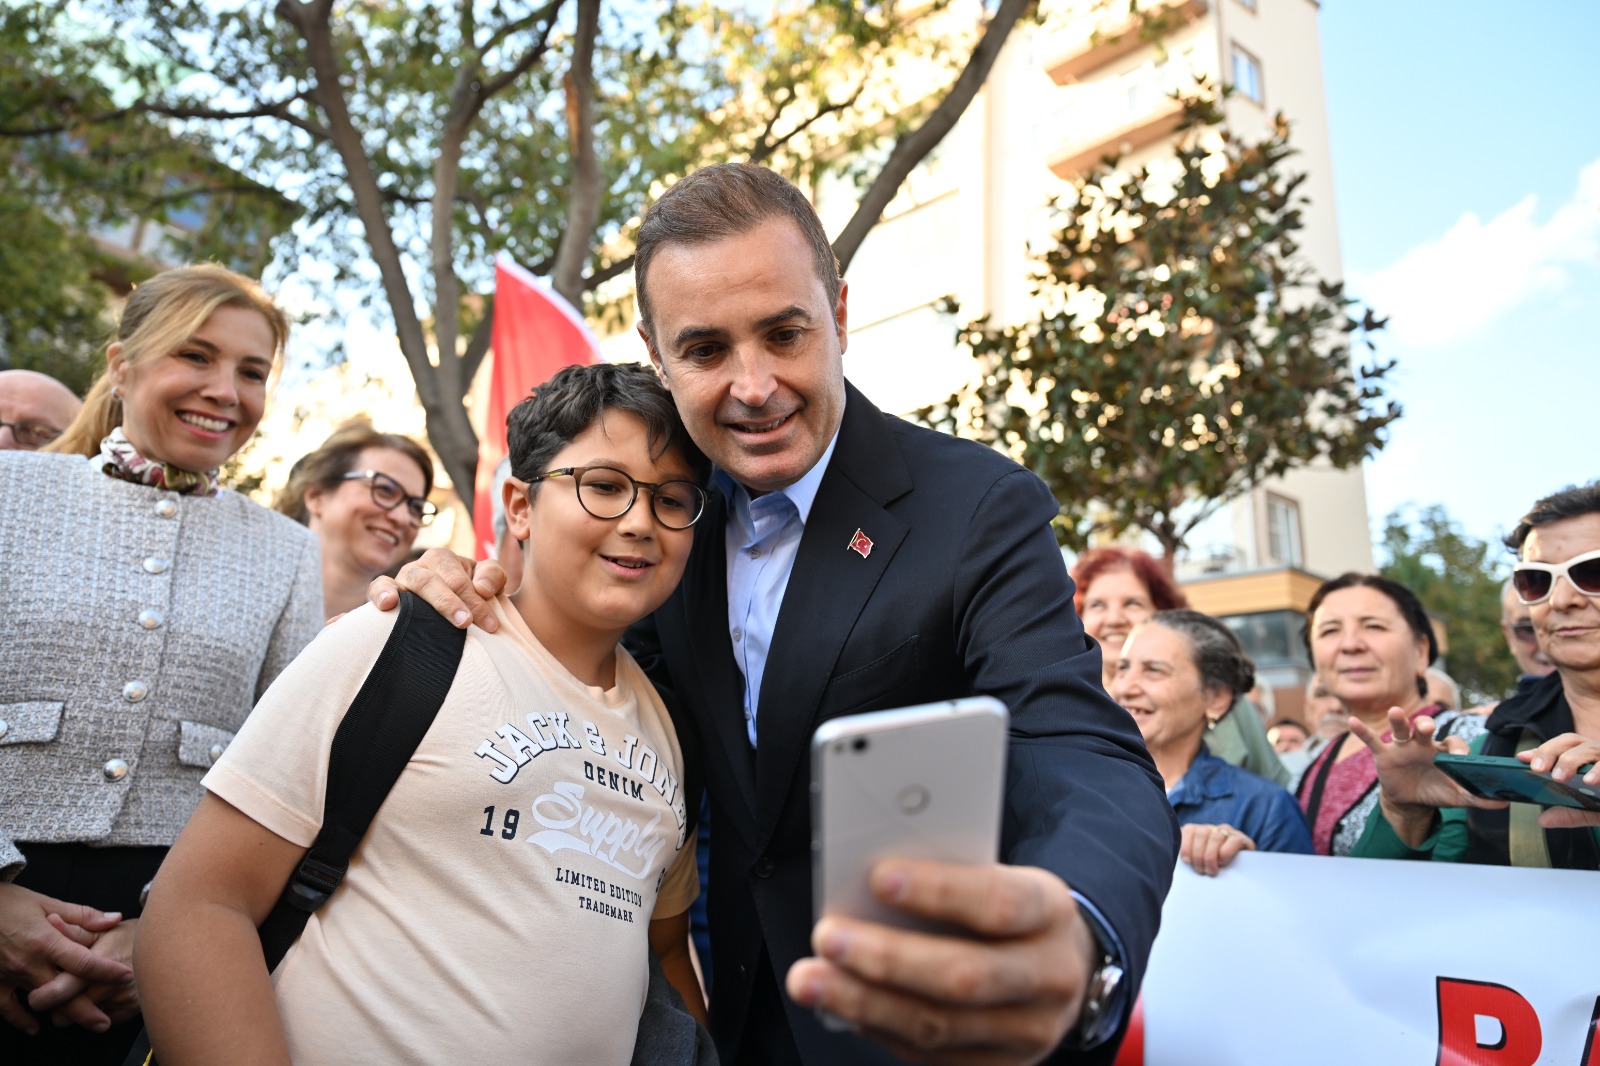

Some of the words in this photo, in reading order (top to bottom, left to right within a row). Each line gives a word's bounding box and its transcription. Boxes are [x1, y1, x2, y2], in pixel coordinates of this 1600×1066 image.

[475, 711, 582, 784] JACK
[582, 720, 606, 756] &
[583, 760, 645, 802] DENIM
[480, 805, 520, 841] 19
[531, 781, 666, 880] Supply
[555, 867, 606, 894] LIMITED
[609, 883, 642, 908] EDITION
[578, 895, 634, 923] TRADEMARK
